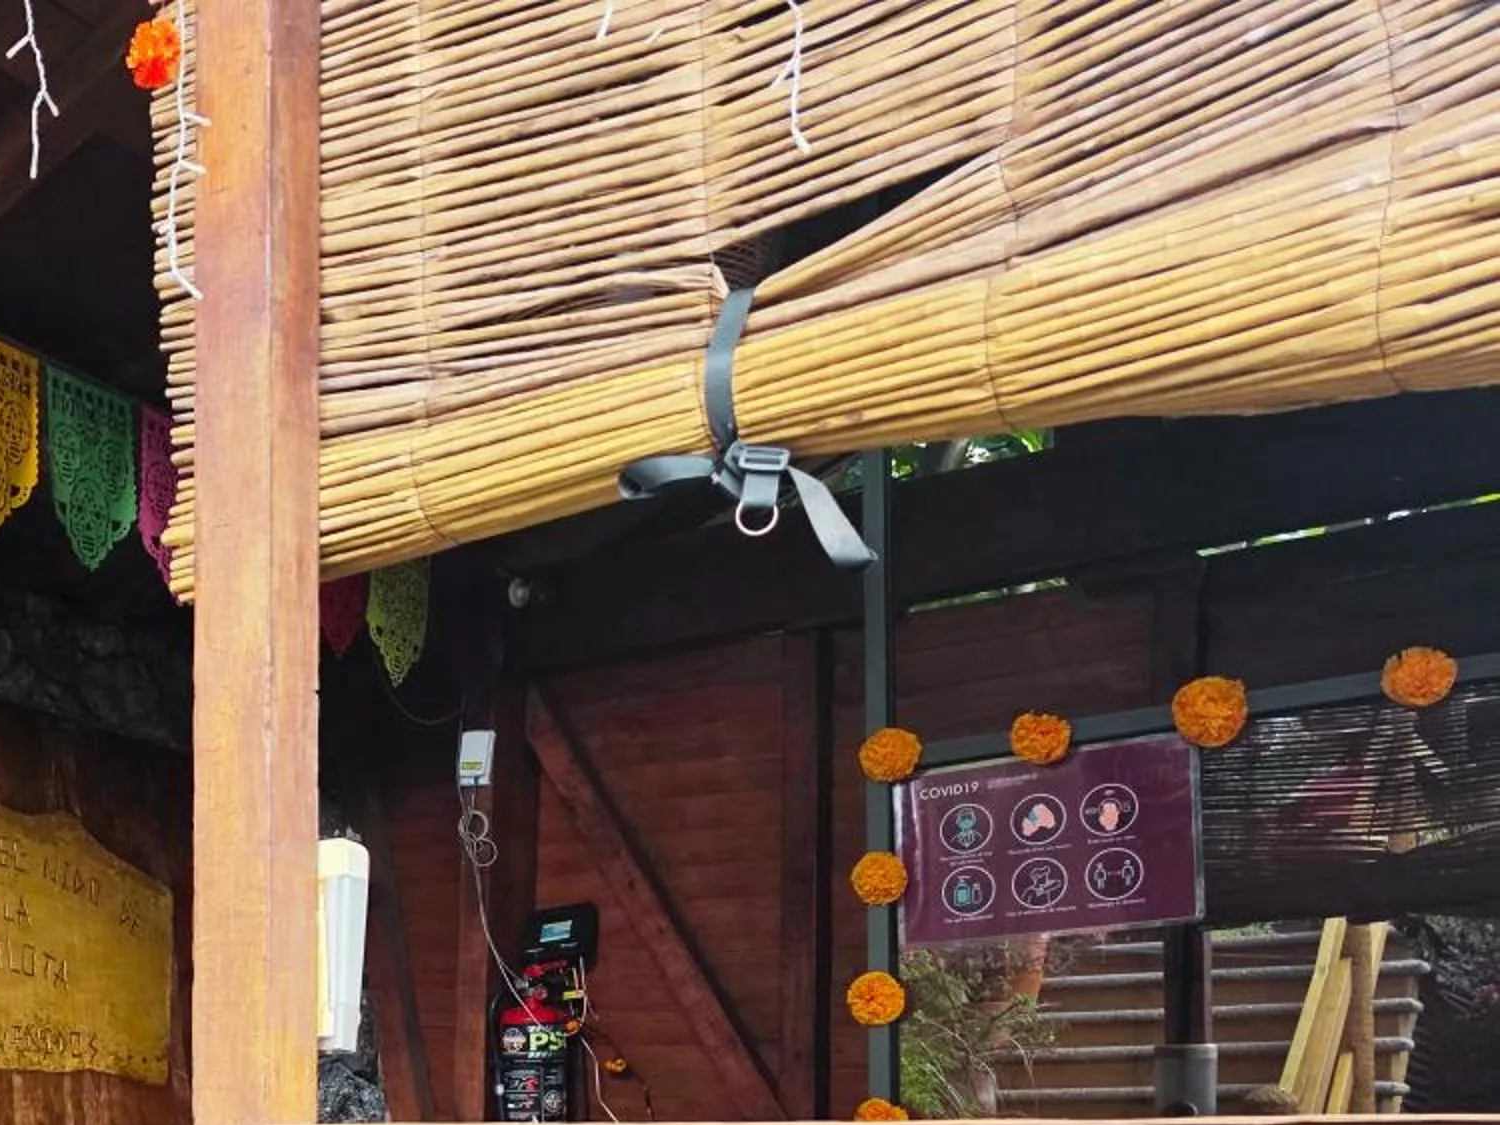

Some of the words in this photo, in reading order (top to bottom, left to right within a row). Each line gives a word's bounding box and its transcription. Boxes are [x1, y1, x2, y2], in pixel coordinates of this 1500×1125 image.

[920, 781, 979, 800] COVID19
[42, 855, 101, 907] NIDO
[2, 894, 34, 929] LA
